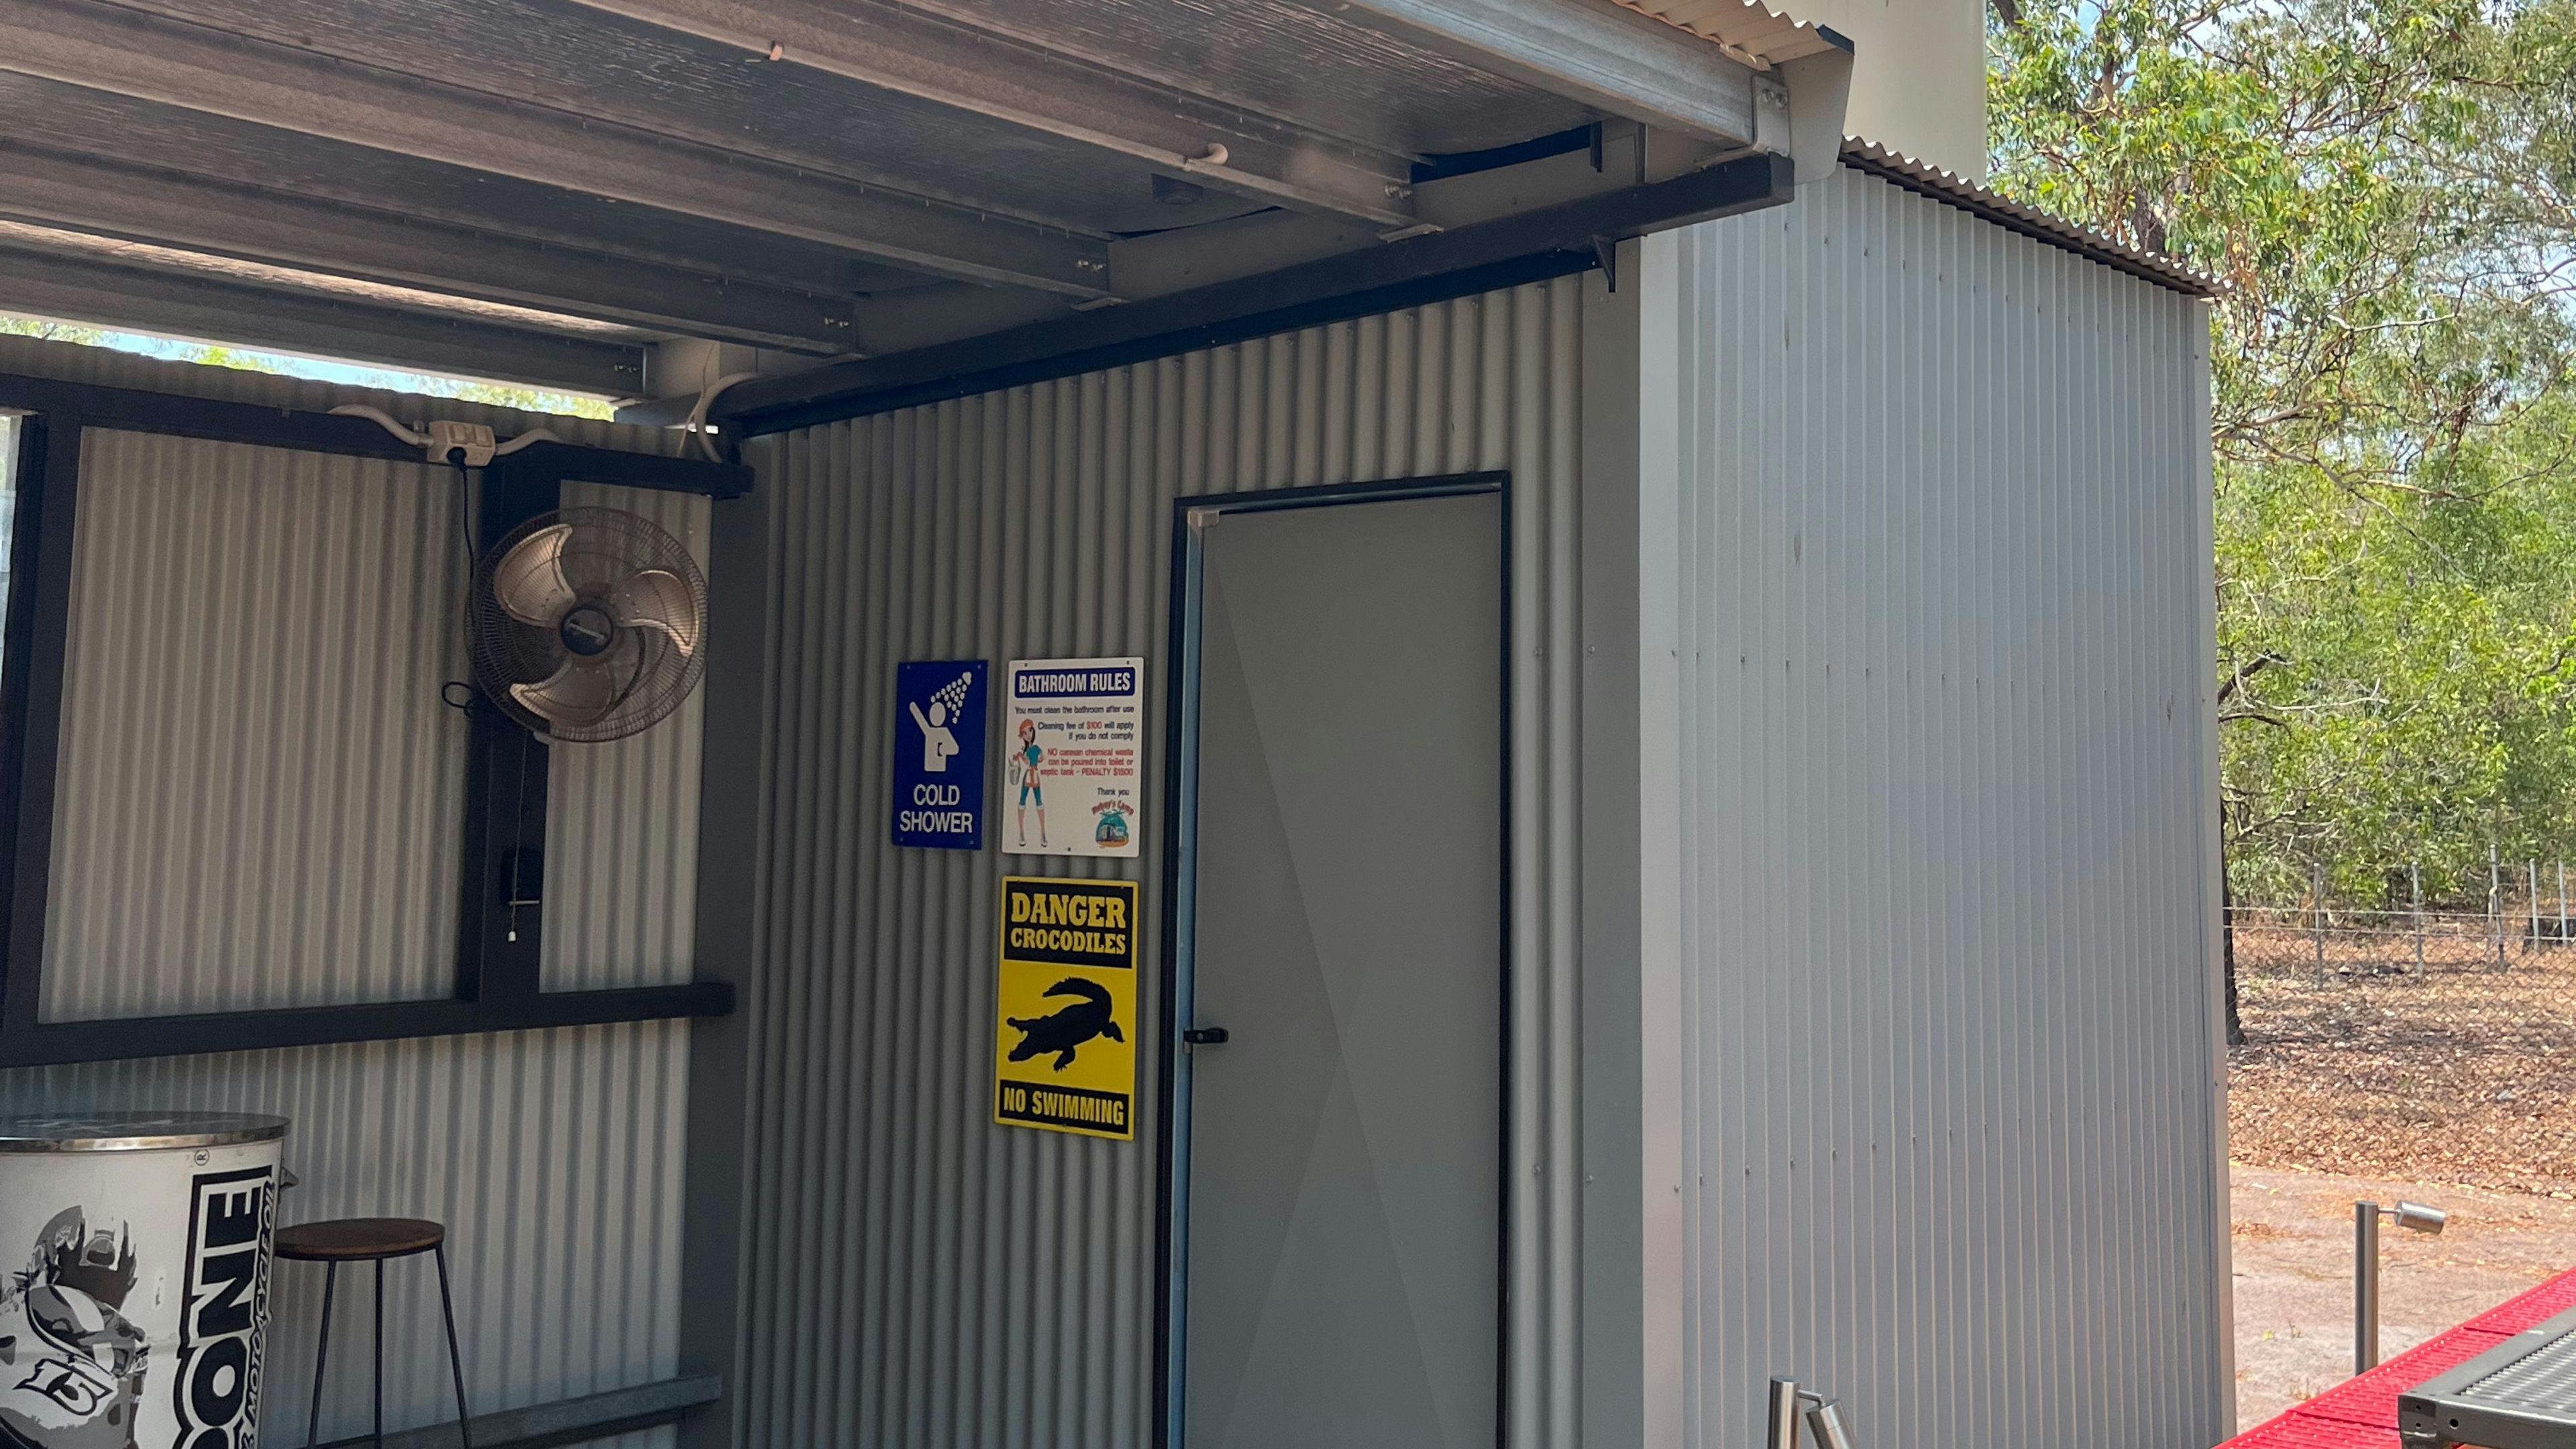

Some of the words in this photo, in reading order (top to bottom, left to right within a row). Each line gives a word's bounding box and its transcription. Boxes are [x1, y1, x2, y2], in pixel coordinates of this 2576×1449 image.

[1018, 674, 1087, 694] BATHROOM
[1089, 673, 1131, 692] RULES
[1038, 722, 1064, 731] Cleaning
[1086, 721, 1102, 730] $100
[1104, 721, 1114, 729] will
[1116, 722, 1134, 731] apply
[1110, 733, 1134, 741] comply
[1047, 748, 1057, 756] NO
[1085, 748, 1113, 756] chemical
[1071, 759, 1093, 767] poured
[1081, 767, 1112, 775] PENALTY
[913, 784, 960, 806] COLD
[1097, 787, 1116, 796] Thank
[1118, 789, 1130, 797] you
[899, 810, 973, 834] SHOWER
[1011, 892, 1127, 928] DANGER
[1010, 927, 1126, 955] CROCODILES
[1003, 1087, 1026, 1112] NO
[1032, 1090, 1124, 1126] SWIMMING
[263, 1182, 274, 1229] OIL
